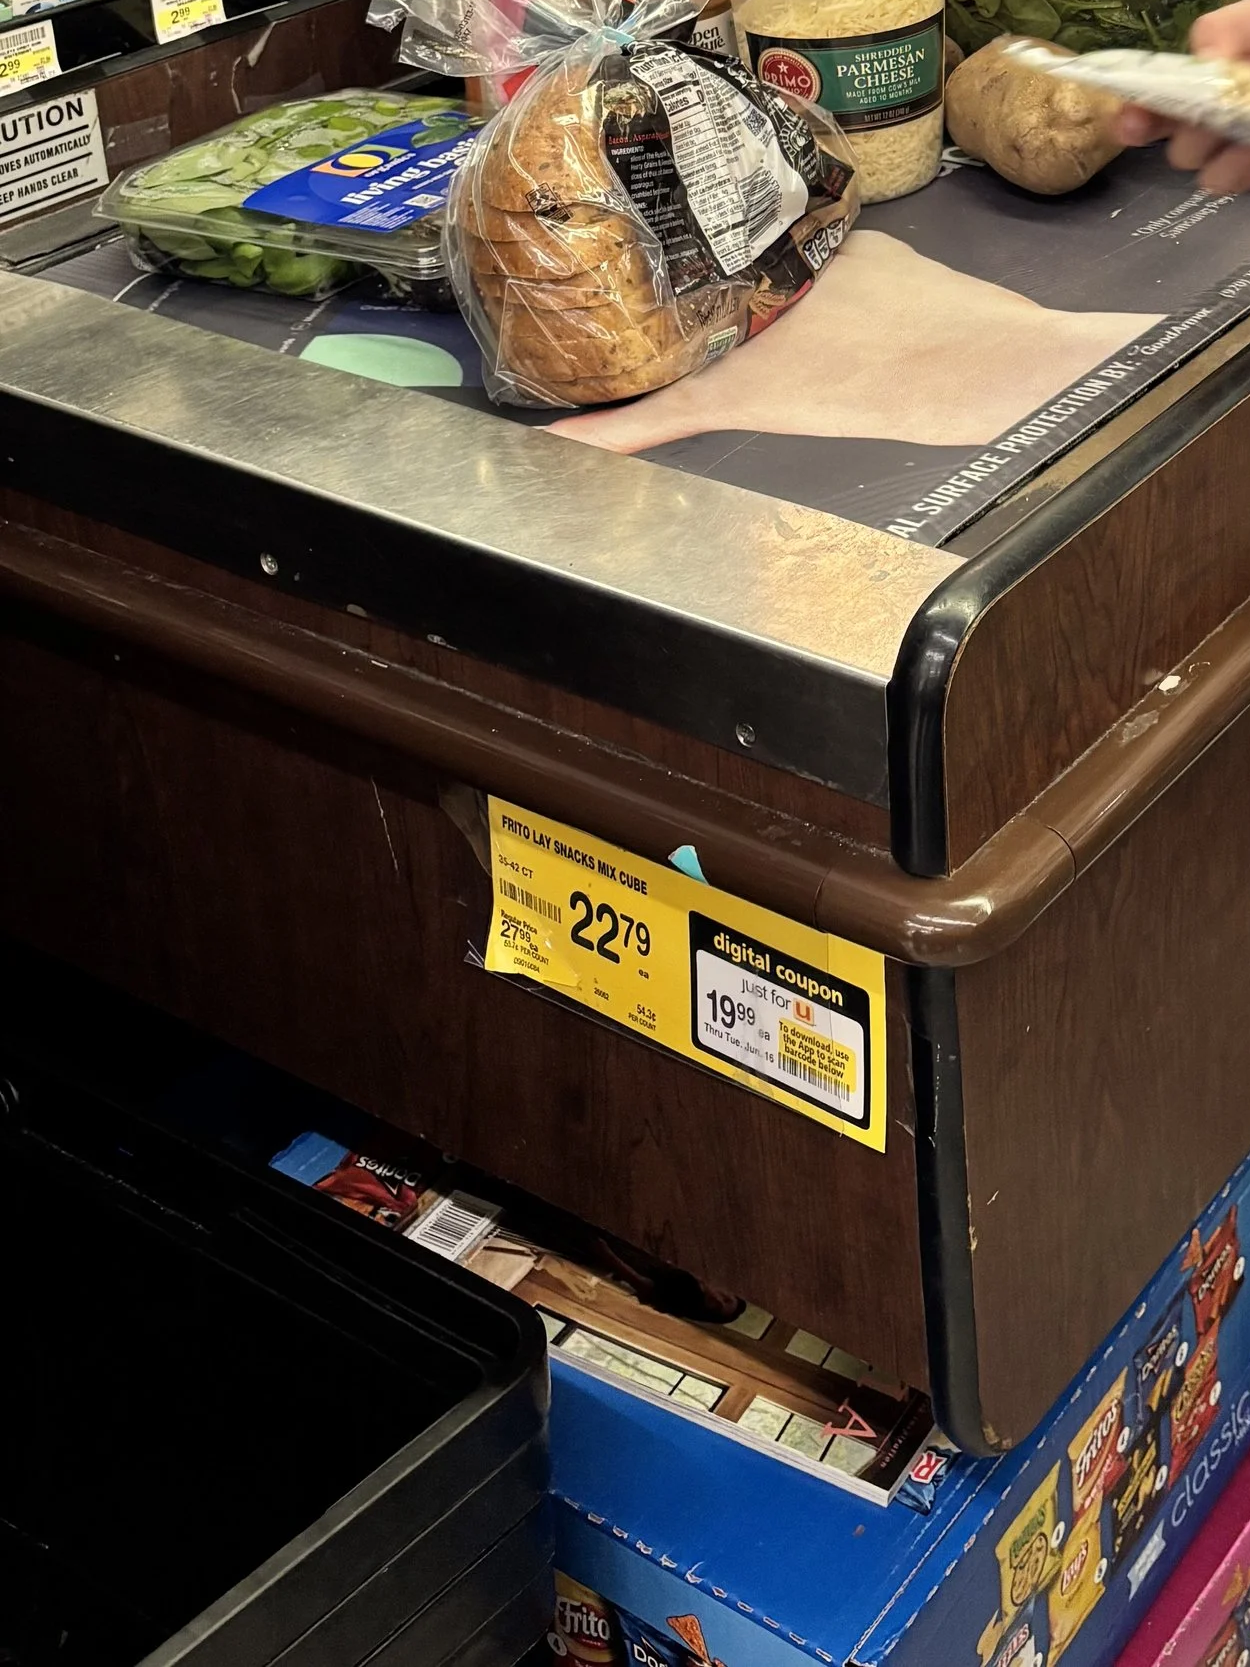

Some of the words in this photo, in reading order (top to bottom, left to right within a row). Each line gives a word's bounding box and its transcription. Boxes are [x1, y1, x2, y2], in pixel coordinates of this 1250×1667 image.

[170, 6, 191, 25] 299
[0, 59, 21, 78] 299
[836, 48, 926, 78] PARMESAN
[854, 44, 912, 63] SHREDDED
[764, 71, 812, 89] PRIMO
[846, 88, 868, 99] MADE
[867, 86, 887, 97] FROM
[908, 77, 922, 88] MILK
[853, 65, 915, 89] CHEESE
[859, 94, 877, 105] AGED
[879, 94, 888, 102] 10
[888, 88, 913, 100] MONTHS
[23, 133, 92, 168] AUTOMATICALLY
[17, 178, 49, 199] HANDS
[50, 167, 80, 187] CLEAR
[340, 166, 431, 206] living
[911, 453, 1013, 518] SURFACE
[994, 369, 1114, 456] PROTECTION
[1096, 356, 1142, 390] BY:
[1140, 307, 1213, 356] GoodArmor
[501, 814, 531, 841] FRITO
[532, 829, 552, 850] LAY
[553, 839, 596, 871] SNACKS
[597, 859, 617, 881] MIX
[619, 870, 649, 896] CUBE
[521, 866, 534, 880] CT
[500, 908, 523, 928] Regular
[522, 920, 538, 936] Price
[500, 918, 532, 943] 2799
[528, 940, 540, 953] ea
[569, 889, 651, 965] 2279
[637, 967, 650, 981] ea
[519, 944, 532, 957] PER
[530, 950, 550, 966] COUNT
[713, 932, 772, 974] digital
[774, 963, 844, 1007] coupon
[740, 978, 769, 1002] just
[769, 989, 792, 1011] for
[627, 1011, 640, 1024] PER
[638, 1015, 657, 1032] COUNT
[706, 988, 757, 1030] 1999
[757, 1028, 772, 1042] ea
[703, 1021, 724, 1040] Thru
[724, 1031, 744, 1049] Tue.
[764, 1051, 776, 1064] 16
[778, 1020, 788, 1034] To
[835, 1048, 850, 1063] use
[782, 1033, 797, 1048] the
[797, 1040, 816, 1060] App
[815, 1047, 826, 1062] to
[826, 1053, 847, 1071] scan
[783, 1043, 817, 1068] barcode
[817, 1059, 845, 1080] below
